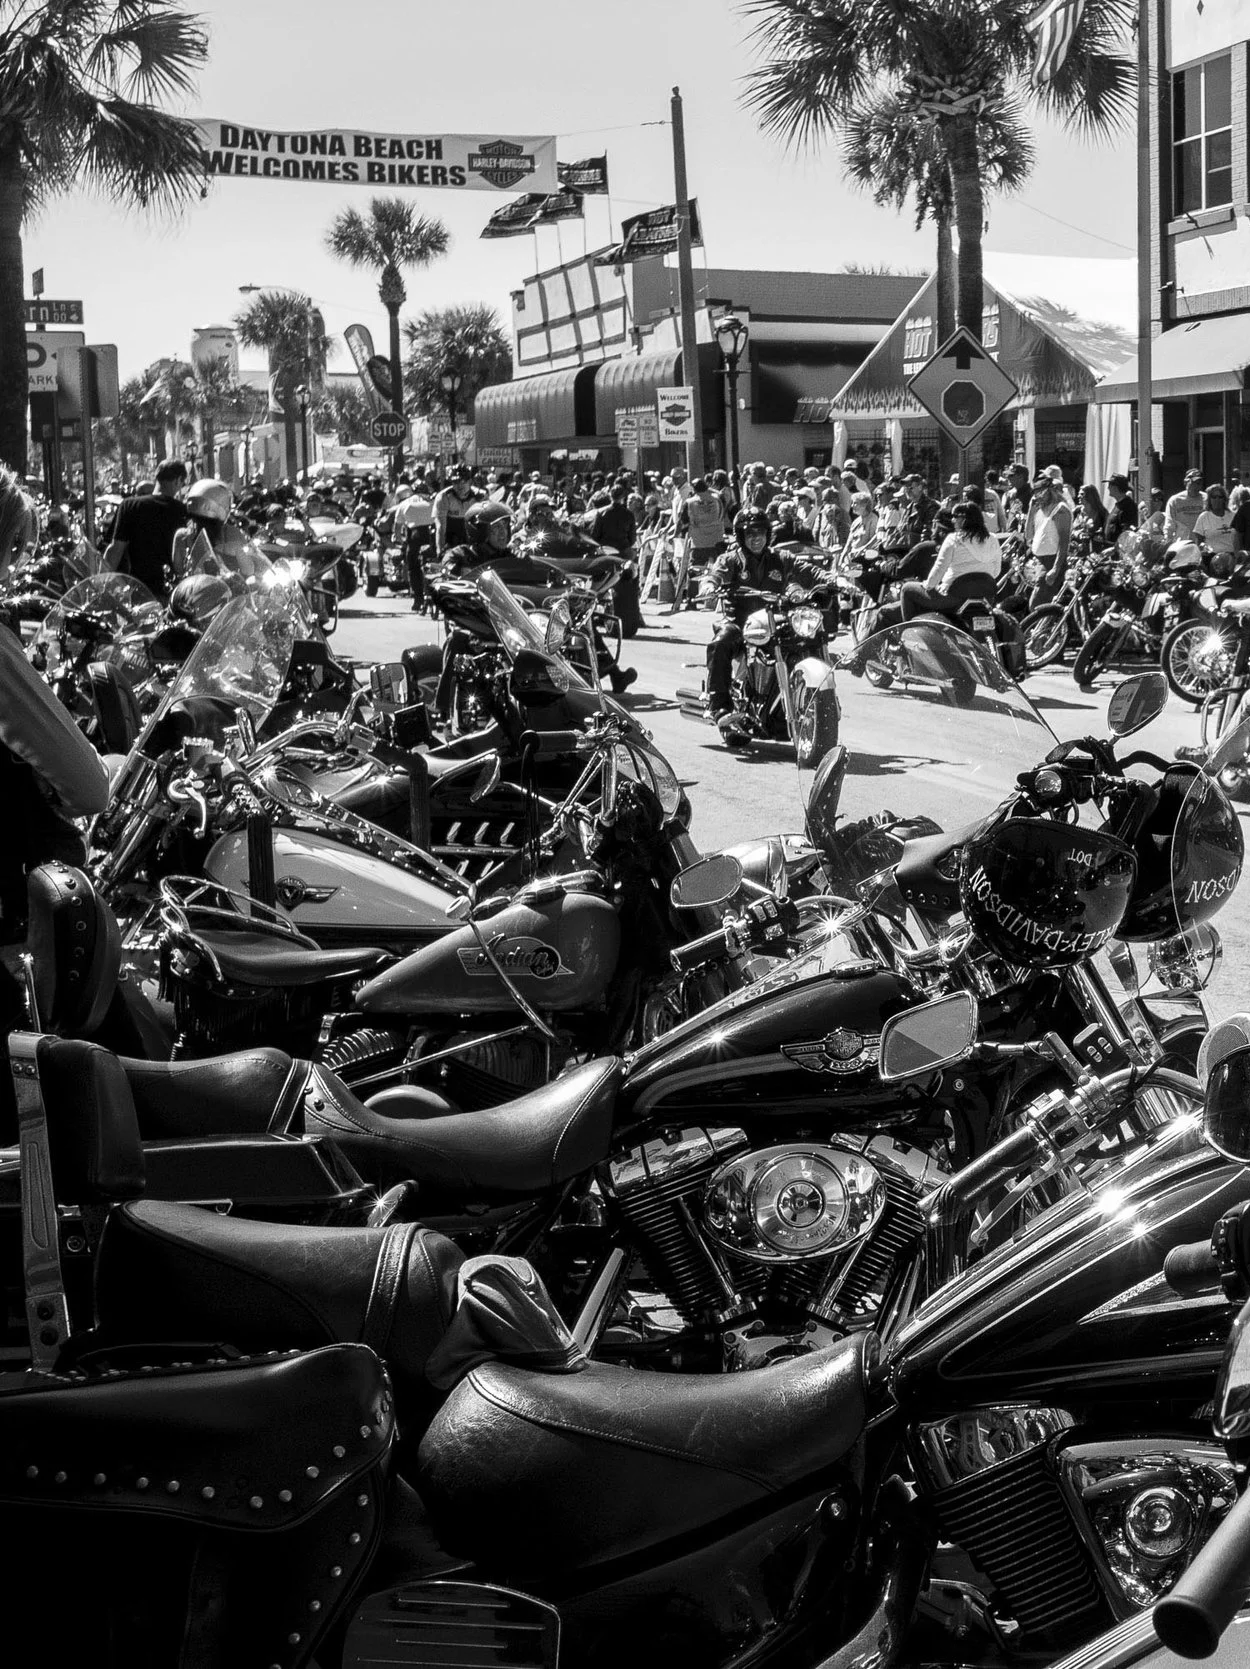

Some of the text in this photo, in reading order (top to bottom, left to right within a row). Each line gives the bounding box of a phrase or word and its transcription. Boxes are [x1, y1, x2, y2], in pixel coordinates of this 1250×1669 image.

[220, 124, 443, 160] DAYTONA BEACH
[205, 150, 467, 186] WELCOMES BIKERS
[373, 422, 405, 437] STOP
[1067, 847, 1093, 867] DOT
